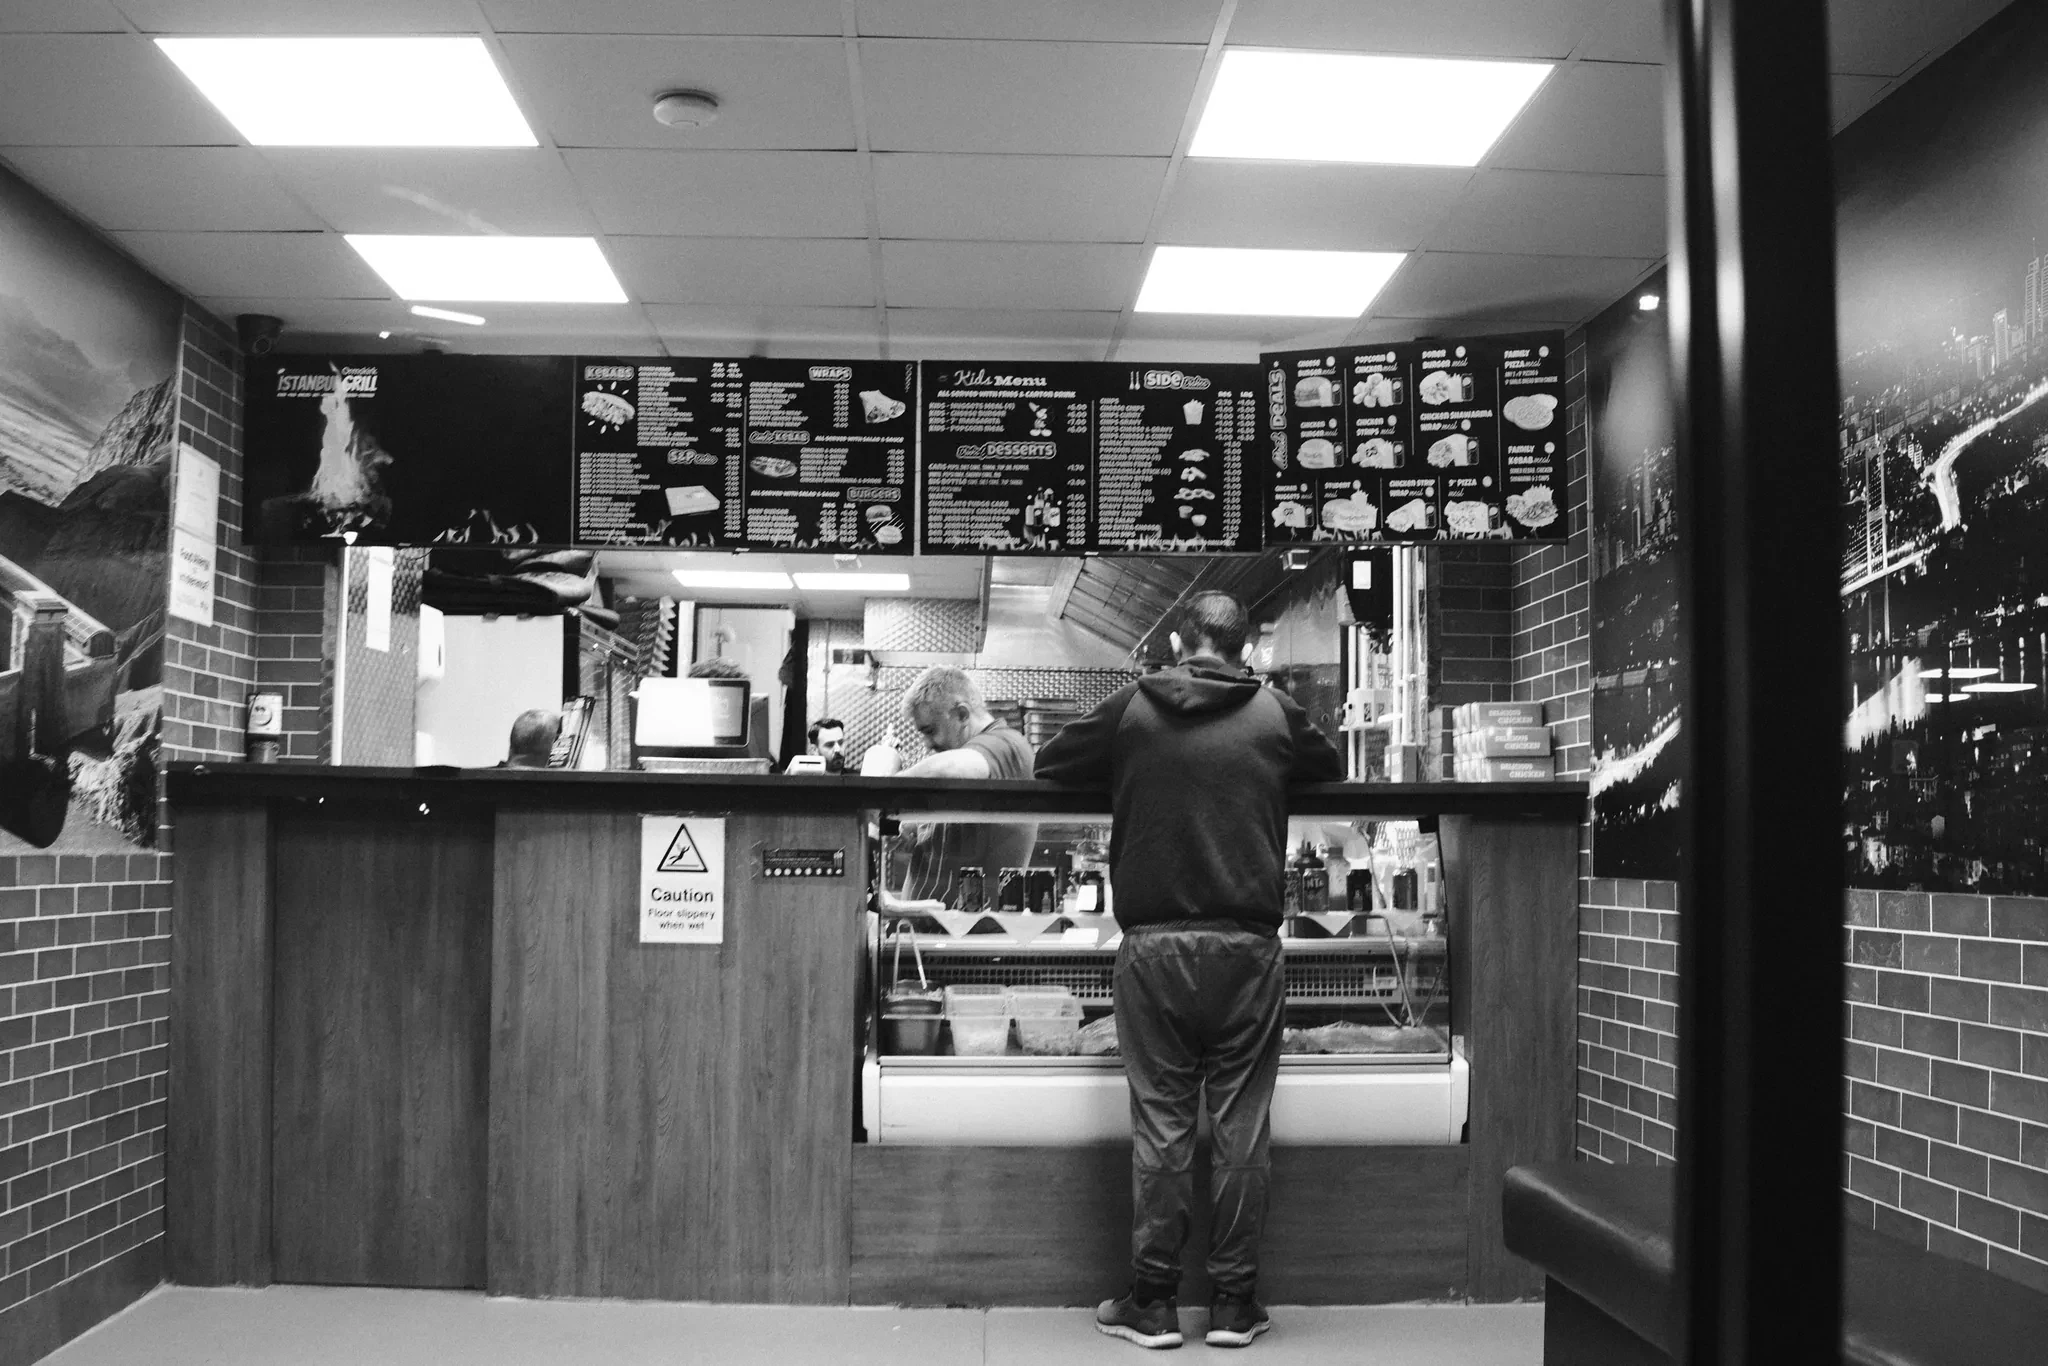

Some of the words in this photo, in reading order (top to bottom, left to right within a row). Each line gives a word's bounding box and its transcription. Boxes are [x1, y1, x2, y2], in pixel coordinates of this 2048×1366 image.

[812, 369, 850, 379] WRAPS
[953, 369, 992, 386] Kids
[993, 375, 1047, 386] Menu
[1147, 374, 1180, 386] SIDE
[1271, 373, 1284, 426] DEALS
[1498, 716, 1533, 724] CHICKEN
[1505, 742, 1541, 750] CHICKEN
[651, 887, 714, 903] Caution
[648, 908, 673, 918] Floor
[676, 908, 715, 920] slippery
[659, 921, 684, 930] when
[688, 921, 704, 930] wet
